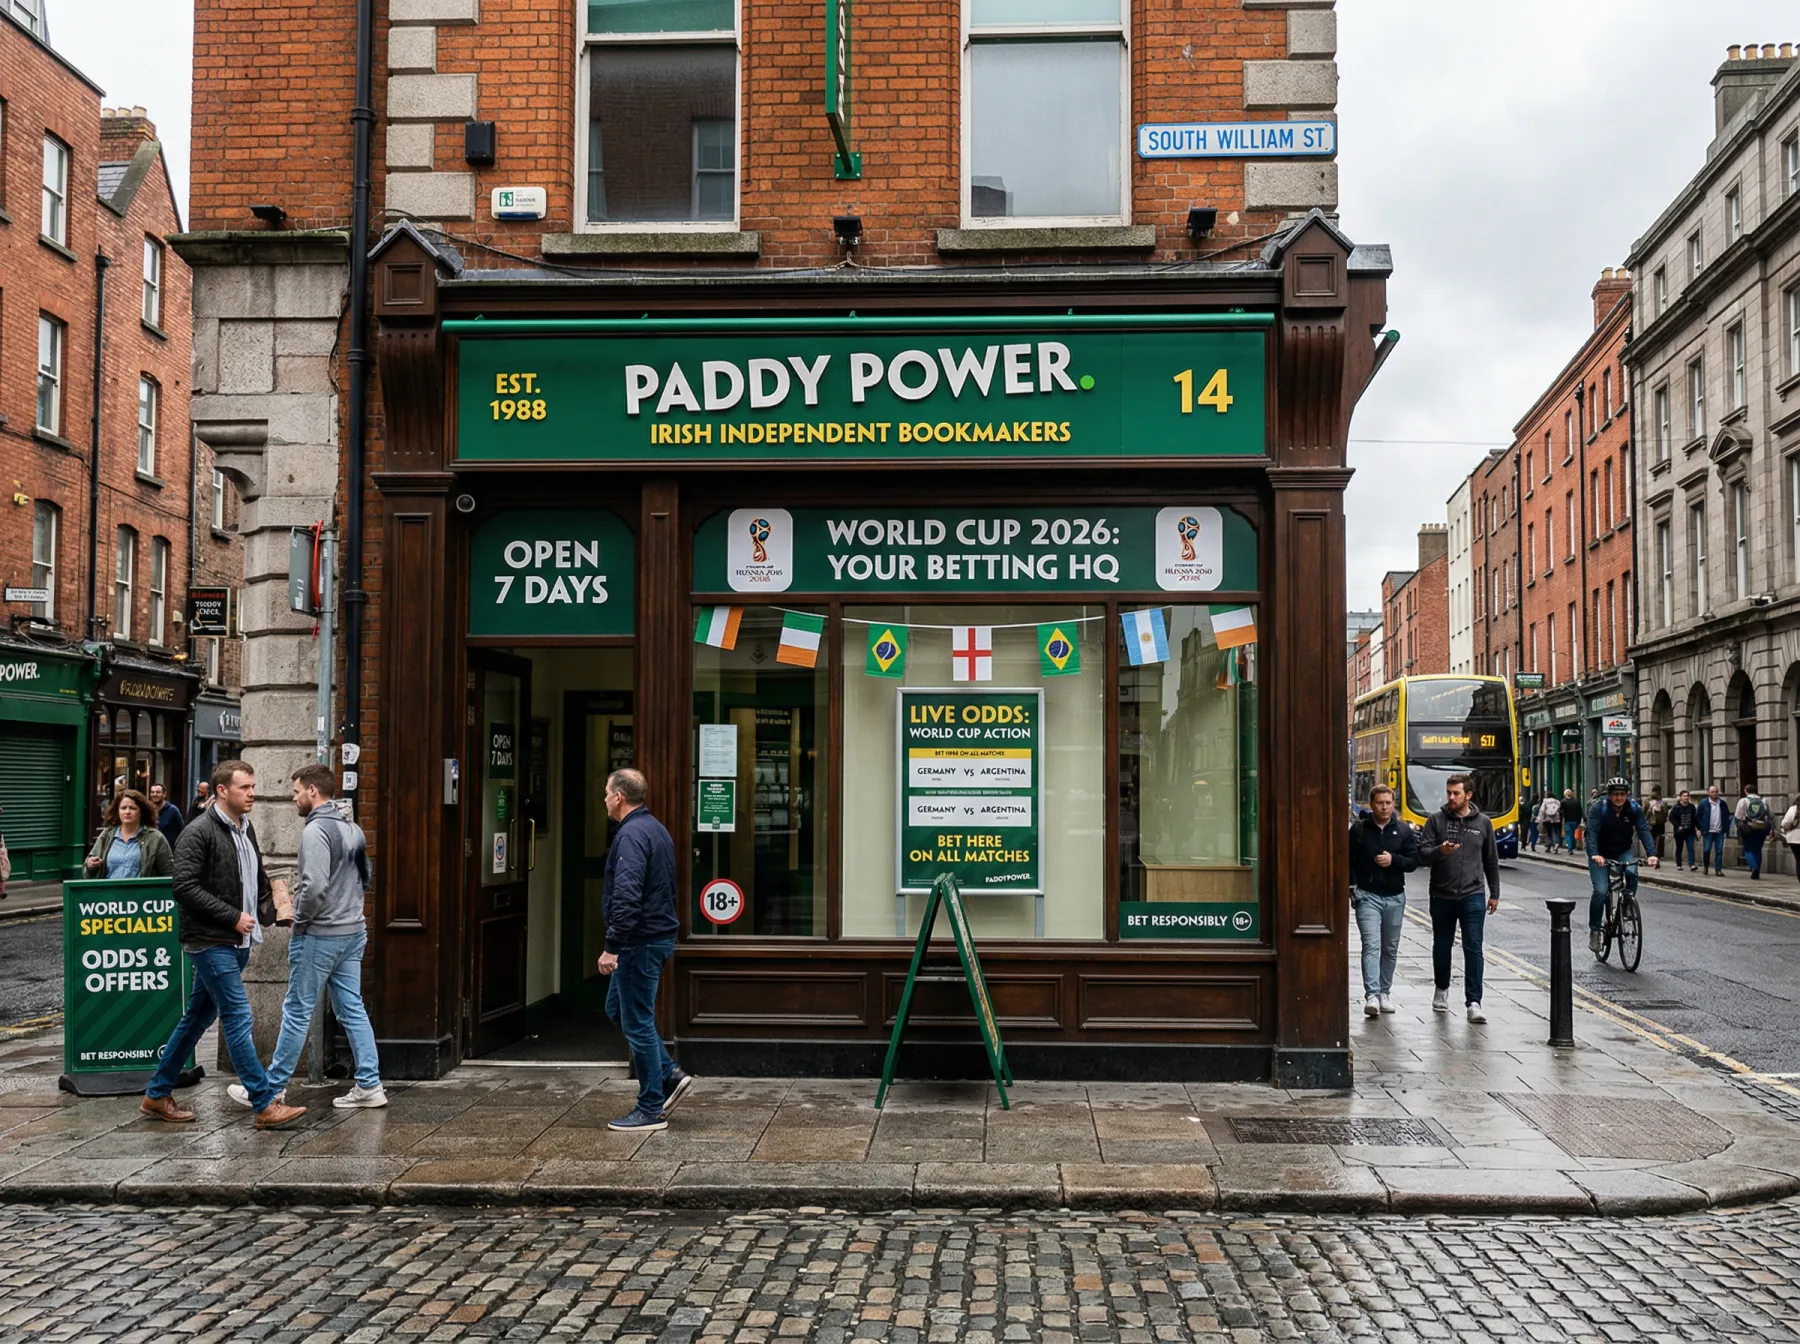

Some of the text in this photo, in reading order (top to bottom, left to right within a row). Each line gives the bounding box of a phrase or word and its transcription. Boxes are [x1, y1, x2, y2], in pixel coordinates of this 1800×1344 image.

[1146, 125, 1327, 150] SOUTH WILLIAM ST
[497, 373, 540, 393] EST.
[626, 342, 1093, 414] PADDY POWER.
[1173, 369, 1233, 413] 14
[490, 400, 546, 419] 1988
[652, 422, 1071, 443] IRISH INDEPENDENT BOOKMAKERS
[827, 519, 1119, 545] WORLD CUP 2026:
[504, 541, 598, 568] OPEN
[828, 554, 1119, 583] YOUR BETTING HQ
[495, 576, 608, 603] 7 DAYS
[911, 706, 1029, 723] LIVE ODDS:
[493, 734, 511, 748] OPEN
[910, 728, 1030, 738] WORLD CUP ACTION
[492, 752, 512, 766] 7 DAYS
[964, 769, 974, 777] VS
[938, 835, 1001, 847] BET HERE
[910, 850, 1029, 862] ON ALL MATCHES
[79, 899, 176, 915] WORLD CUP
[706, 892, 738, 911] 18+
[81, 916, 172, 935] SPECIALS!
[1128, 915, 1148, 925] BET
[1152, 916, 1227, 926] RESPONSIBLY
[82, 948, 171, 969] ODDS &
[86, 971, 168, 992] OFFERS
[81, 1052, 96, 1060] BET
[98, 1050, 154, 1059] RESPONSIBLY
